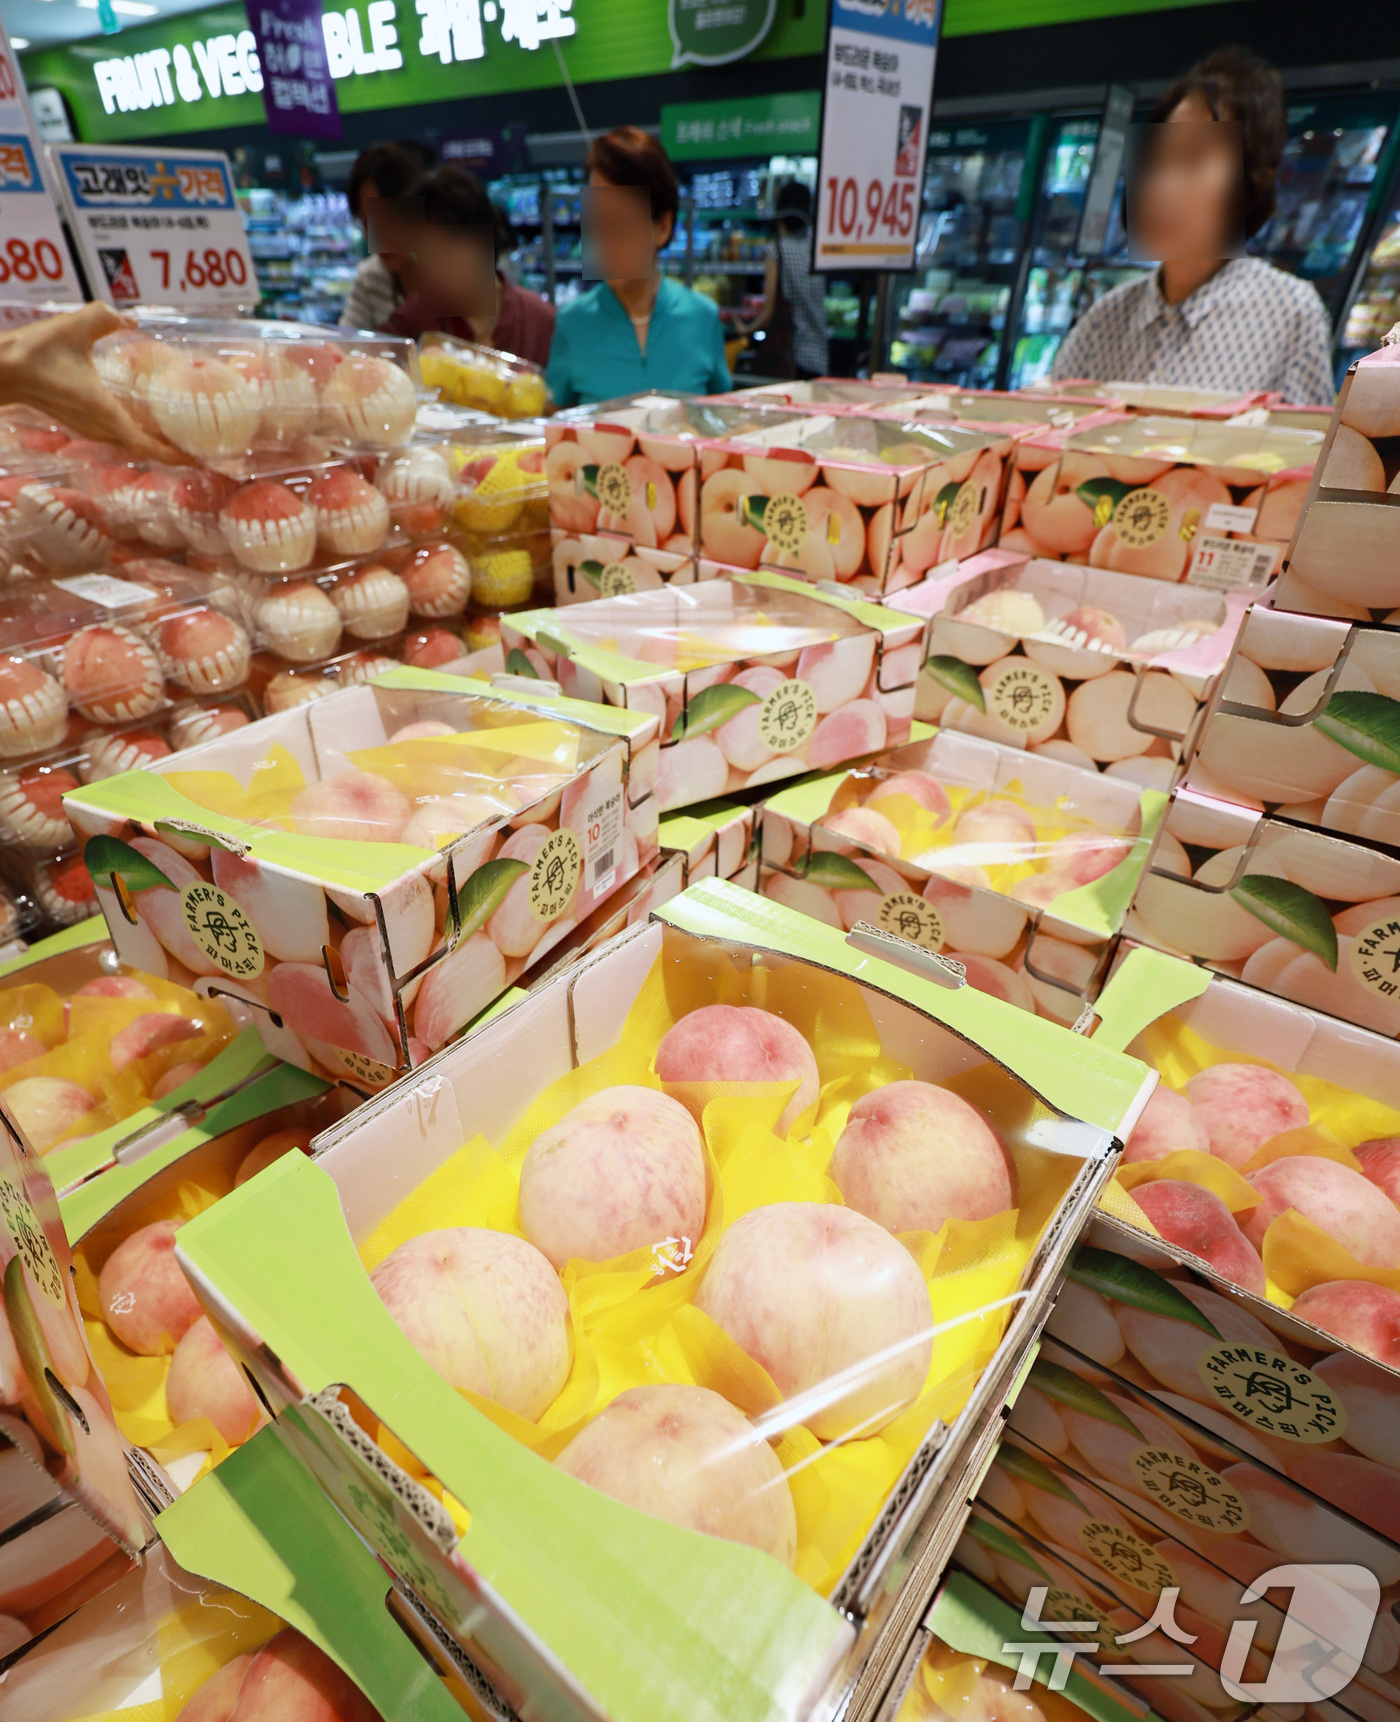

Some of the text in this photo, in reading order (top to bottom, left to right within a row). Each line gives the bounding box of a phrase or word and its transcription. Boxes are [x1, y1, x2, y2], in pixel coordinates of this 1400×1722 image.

[93, 48, 175, 115] FRUIT
[172, 43, 202, 103] &
[827, 176, 916, 241] 10,945
[150, 246, 247, 293] 7,680
[1199, 551, 1215, 567] 11
[587, 823, 600, 845] 10
[532, 835, 563, 903] FARMER'S
[564, 837, 578, 873] PICK
[185, 888, 259, 955] FARMER'S PICK
[540, 883, 573, 917] 파머스픽
[880, 896, 926, 922] FARMER'S
[206, 944, 257, 975] 파머스픽
[1206, 1348, 1337, 1435] FARMER'S PICK
[1214, 1385, 1300, 1438] 파머스픽
[1136, 1451, 1242, 1527] FARMER'S PICK
[1142, 1479, 1215, 1528] 파머스픽
[1083, 1523, 1154, 1556] FARMER'S
